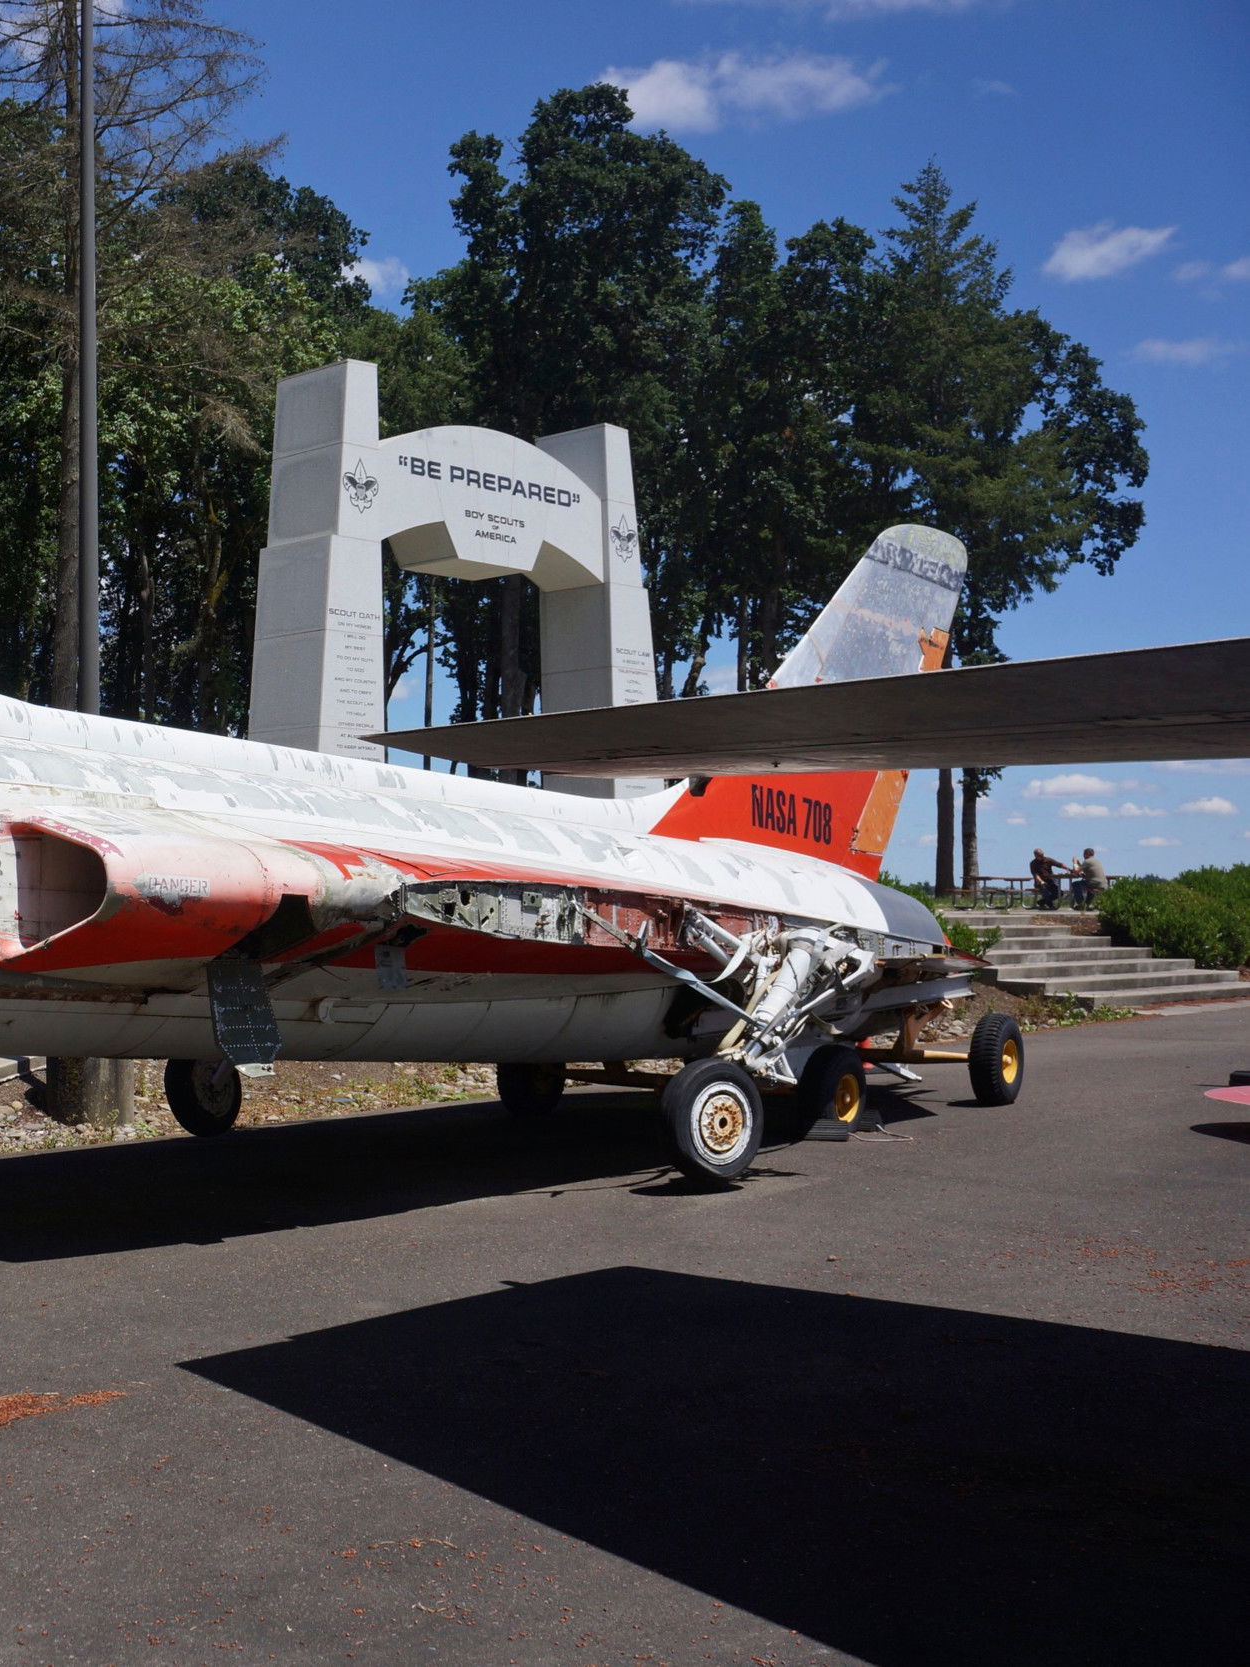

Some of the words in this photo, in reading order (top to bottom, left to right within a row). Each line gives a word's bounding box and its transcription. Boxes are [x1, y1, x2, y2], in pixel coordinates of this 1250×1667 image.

[465, 509, 485, 520] BOY
[487, 513, 525, 529] SCOUTS
[474, 529, 517, 544] AMERICA
[328, 607, 357, 619] SCOUT
[359, 612, 380, 621] OATH
[751, 783, 797, 837] NASA
[802, 797, 832, 845] 708
